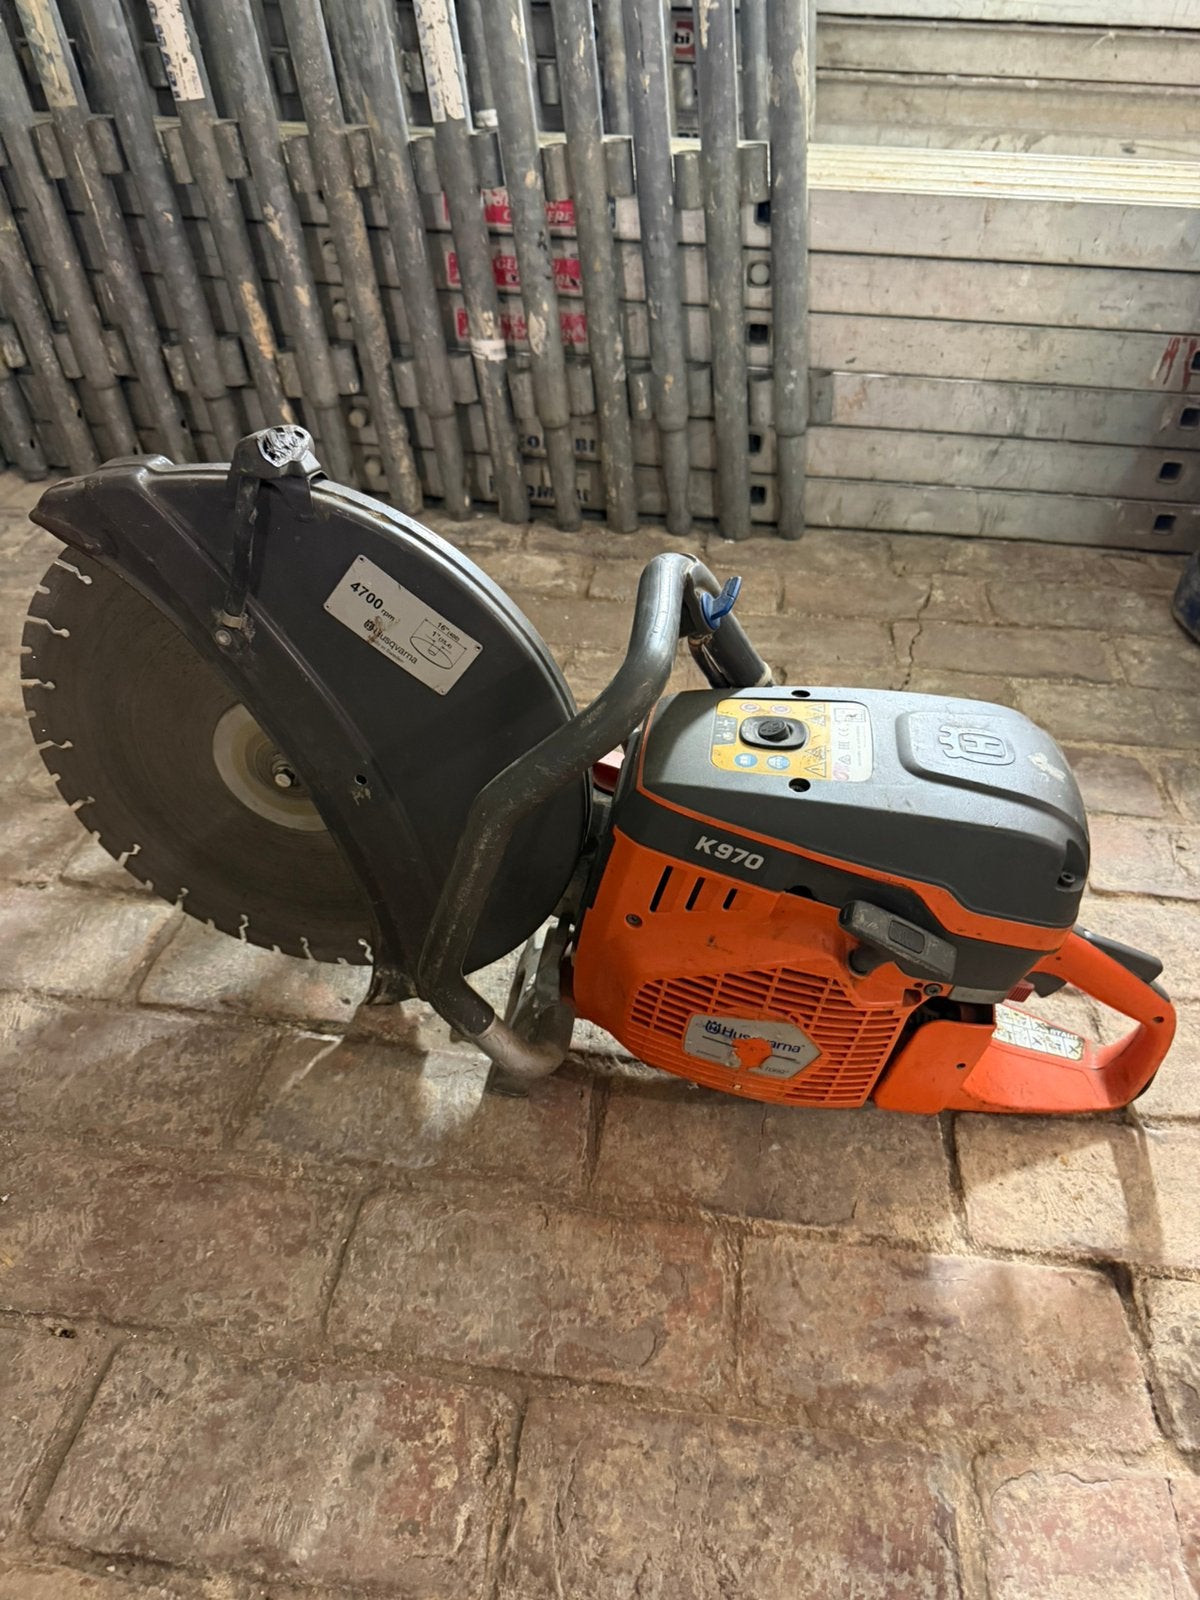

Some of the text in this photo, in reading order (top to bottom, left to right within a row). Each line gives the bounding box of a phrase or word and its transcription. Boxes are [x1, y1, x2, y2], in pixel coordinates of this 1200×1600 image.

[350, 582, 396, 622] 4700 rpm
[721, 1026, 801, 1053] Husarna
